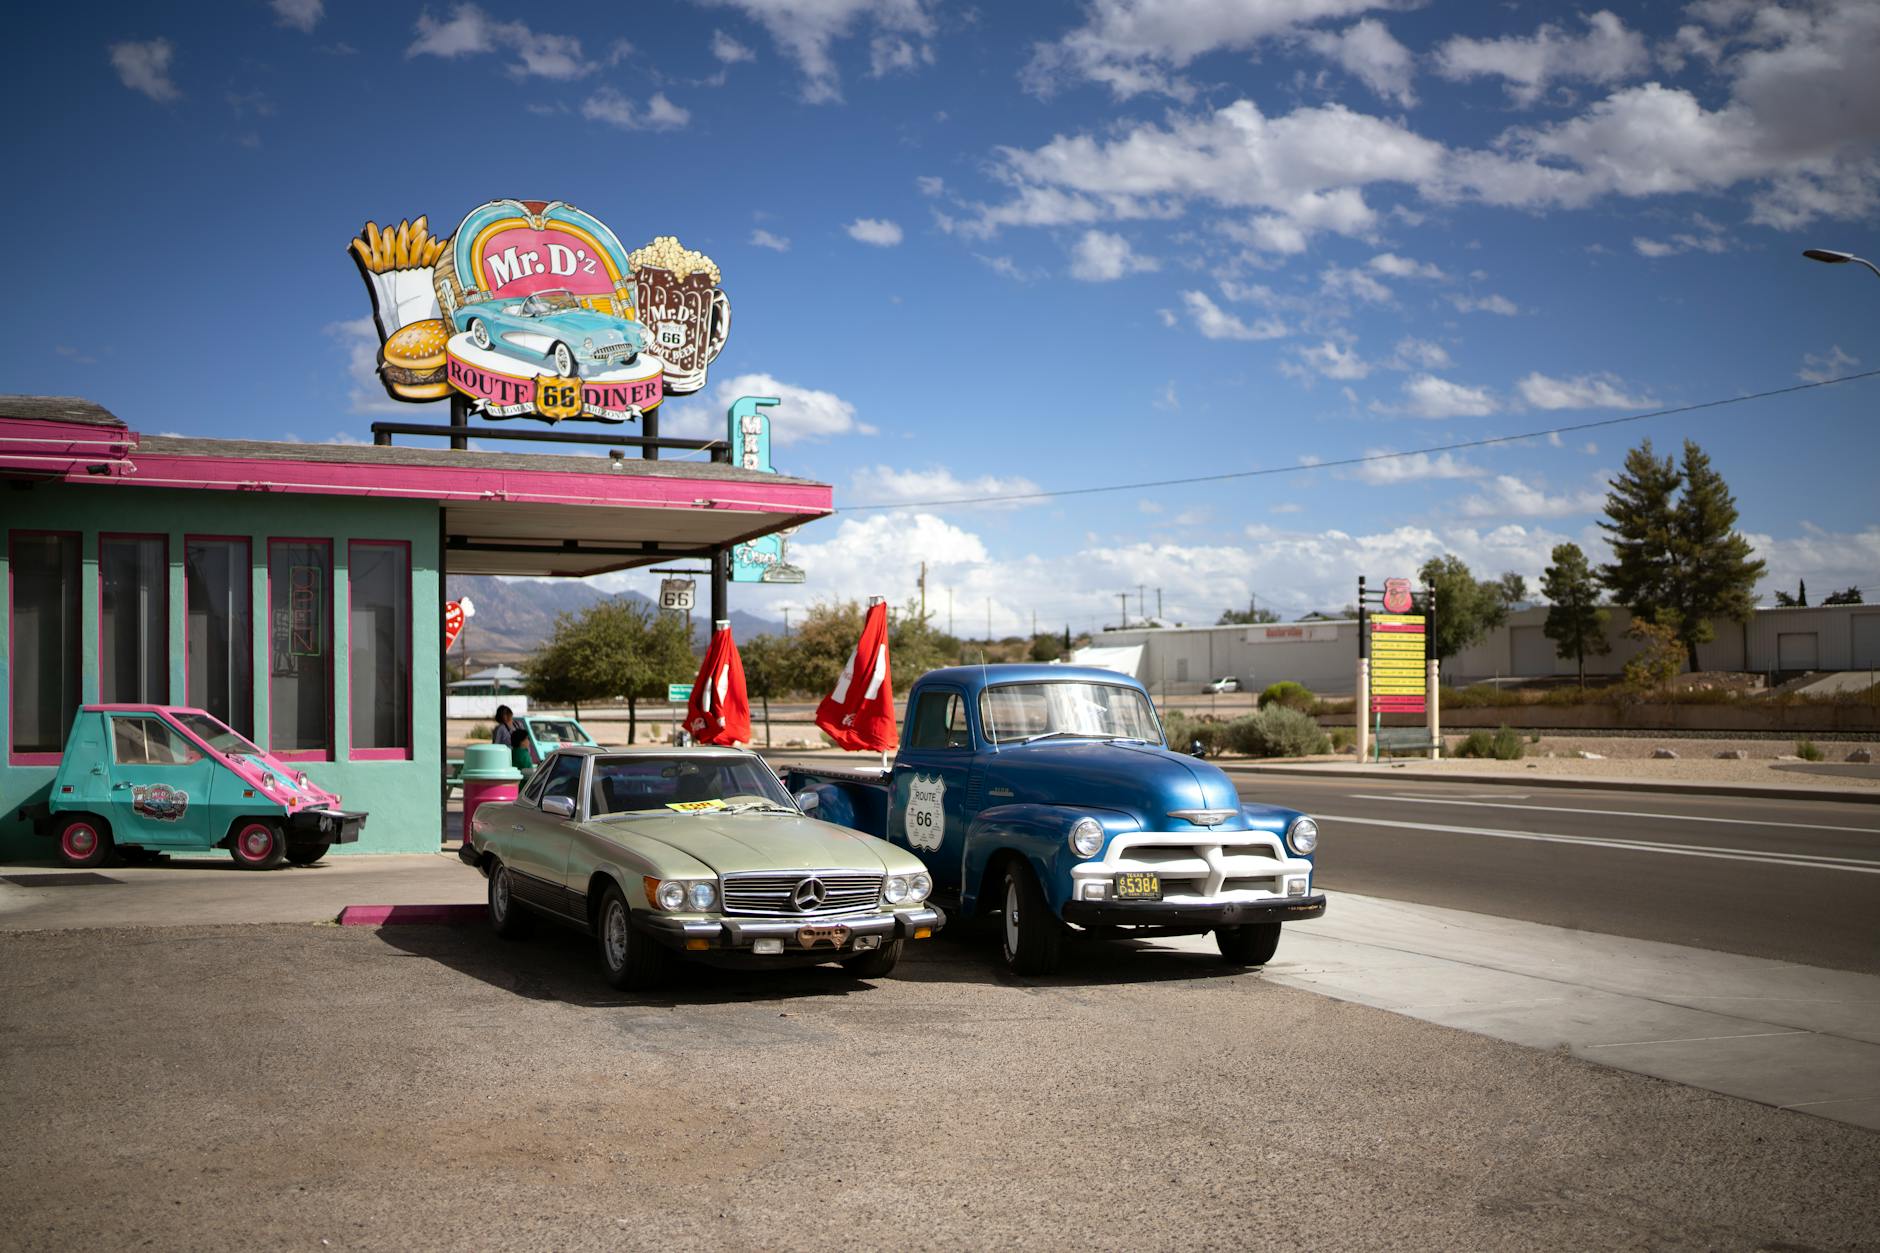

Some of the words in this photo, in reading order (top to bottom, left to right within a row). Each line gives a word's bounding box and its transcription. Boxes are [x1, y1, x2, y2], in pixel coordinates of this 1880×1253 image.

[487, 246, 545, 289] Mr.
[545, 243, 597, 276] D'z
[662, 332, 681, 344] 66
[451, 361, 529, 404] ROUTE
[544, 385, 575, 408] 66
[584, 382, 657, 407] DINER
[664, 592, 688, 606] 66
[292, 567, 315, 651] OPEN
[915, 791, 936, 802] ROUTE
[916, 811, 932, 827] 66
[1127, 878, 1158, 892] 5384
